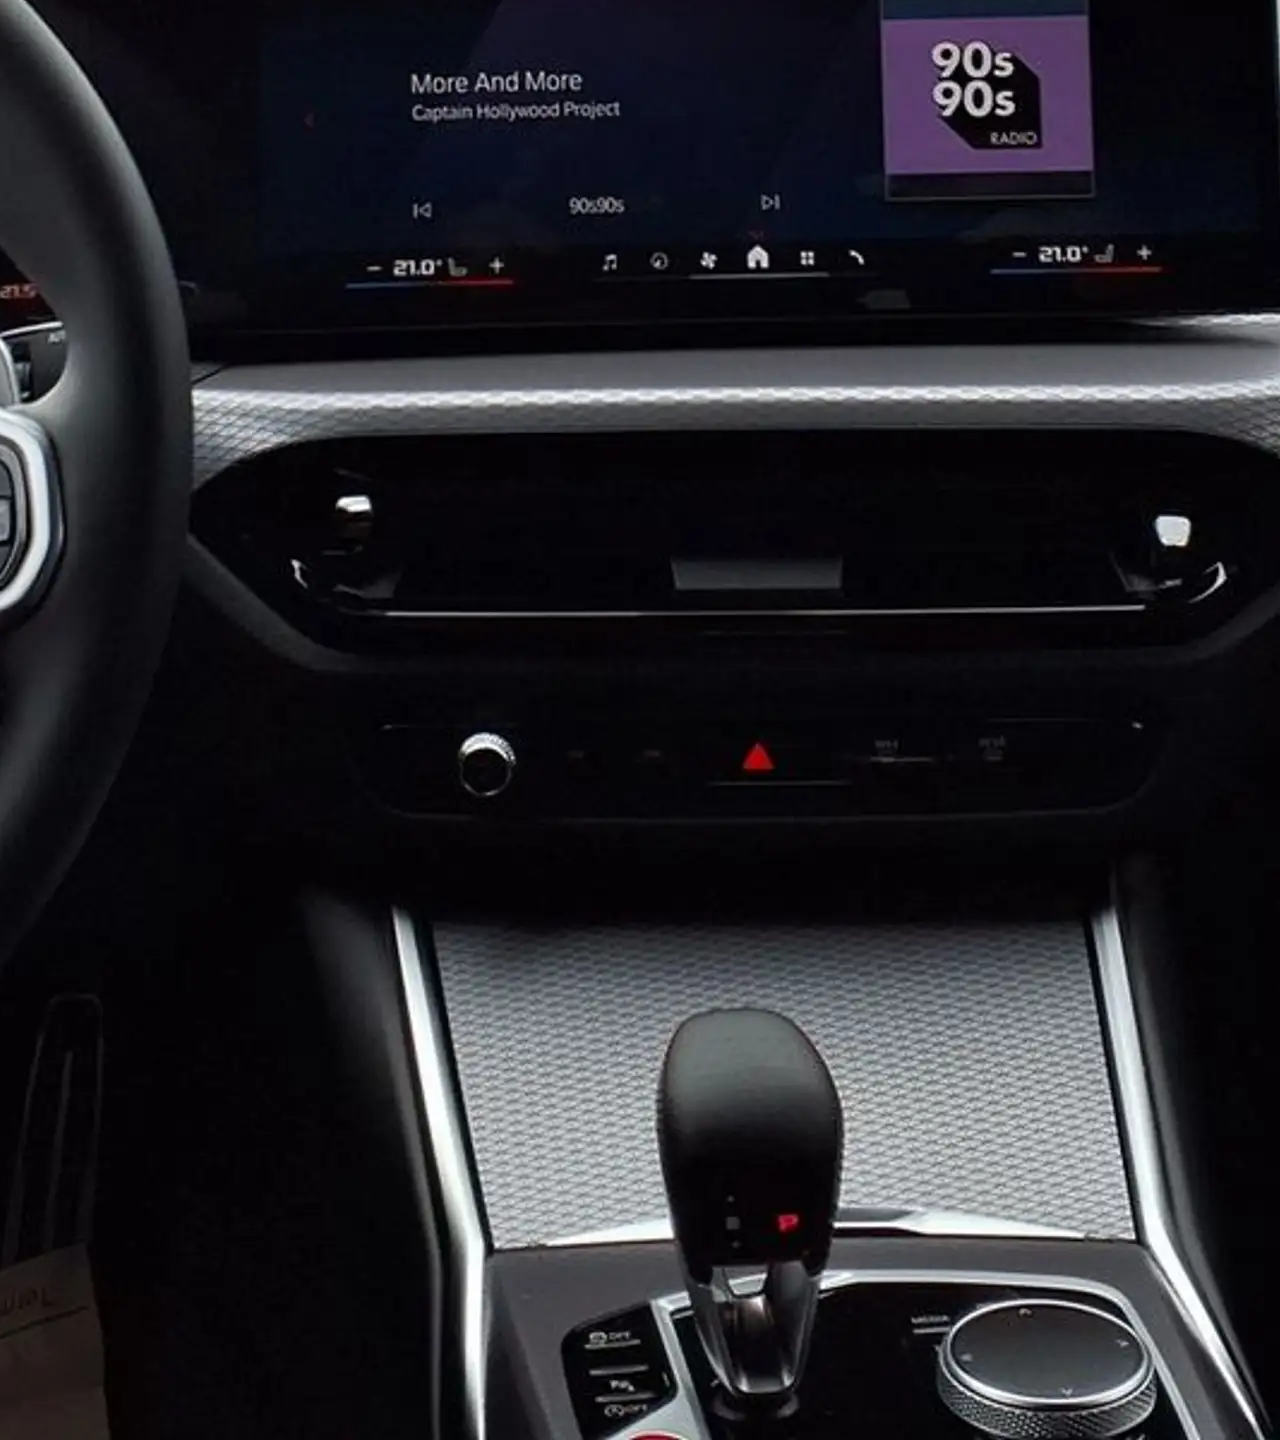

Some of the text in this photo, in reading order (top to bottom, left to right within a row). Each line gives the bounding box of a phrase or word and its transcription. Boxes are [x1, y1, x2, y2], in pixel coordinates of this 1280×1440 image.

[931, 40, 1014, 79] 90s
[411, 70, 583, 94] More And More
[932, 79, 1016, 118] 90s
[412, 99, 620, 123] Captain Hollywood Project
[990, 131, 1037, 145] RADIO
[569, 196, 625, 215] 90s90s
